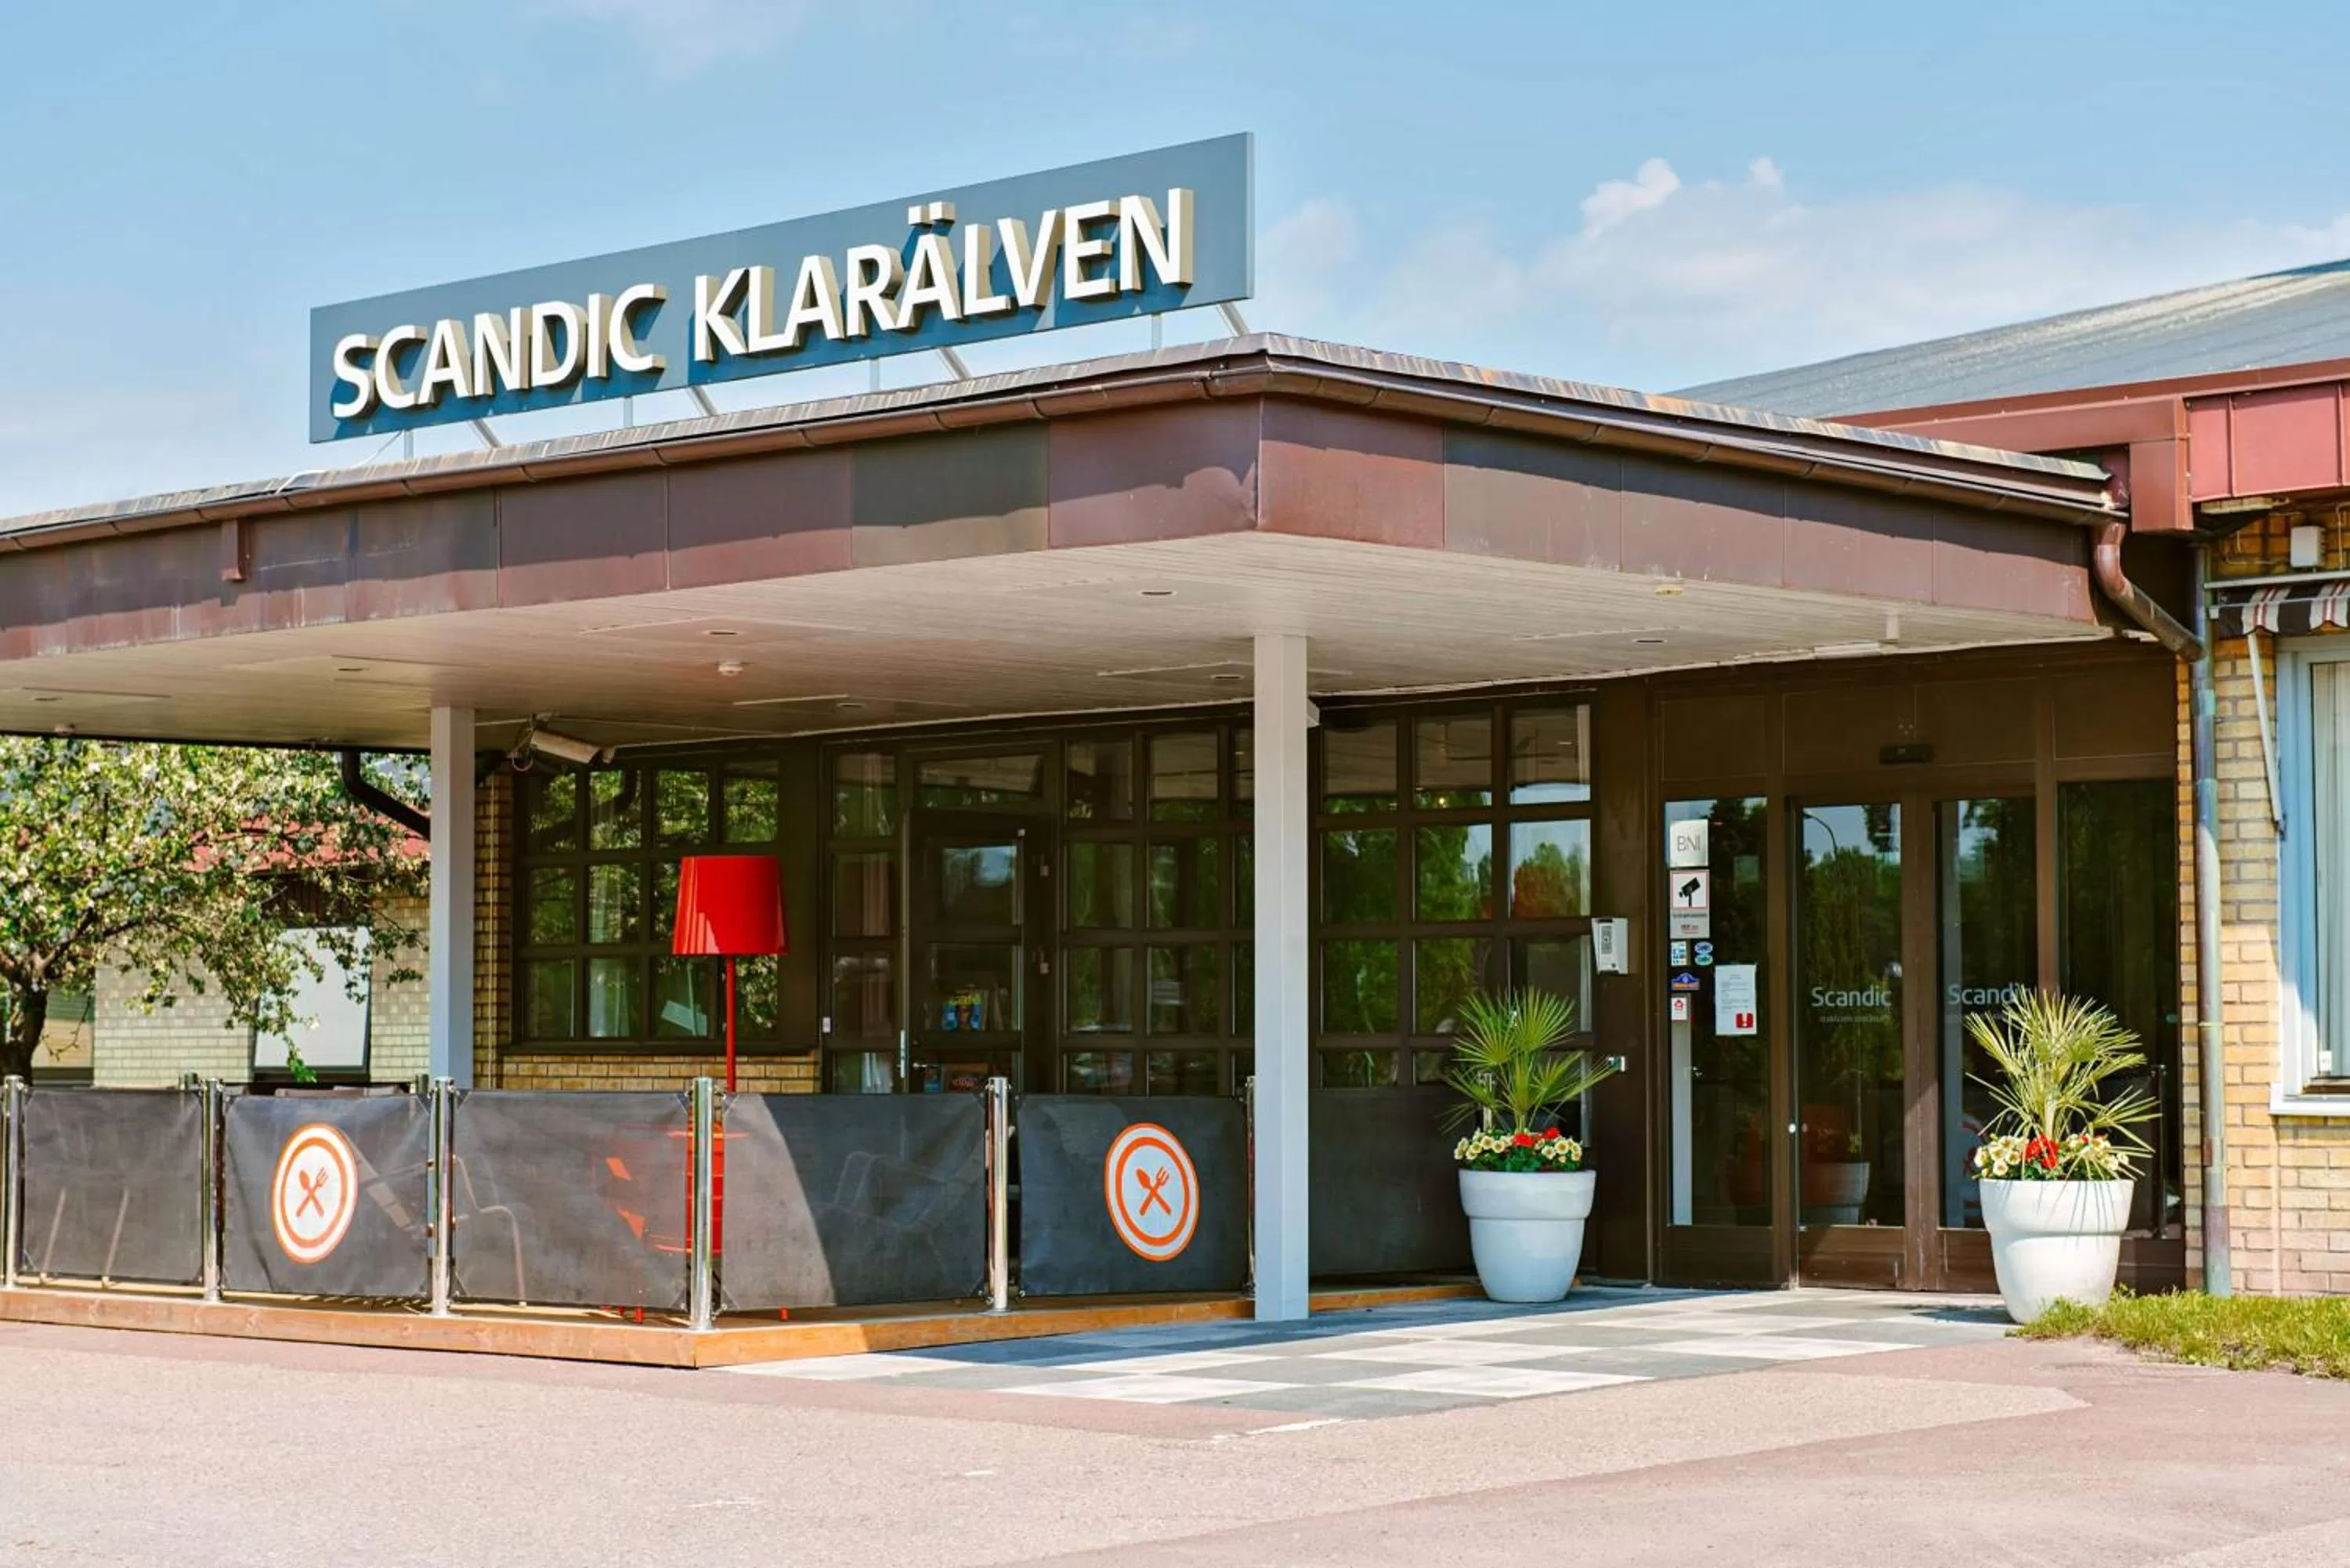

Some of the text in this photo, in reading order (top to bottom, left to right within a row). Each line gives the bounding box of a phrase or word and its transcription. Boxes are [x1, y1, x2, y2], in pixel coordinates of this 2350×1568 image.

[332, 187, 1194, 419] SCANDIC KLARÄLVEN
[1810, 984, 1892, 1007] Scandic
